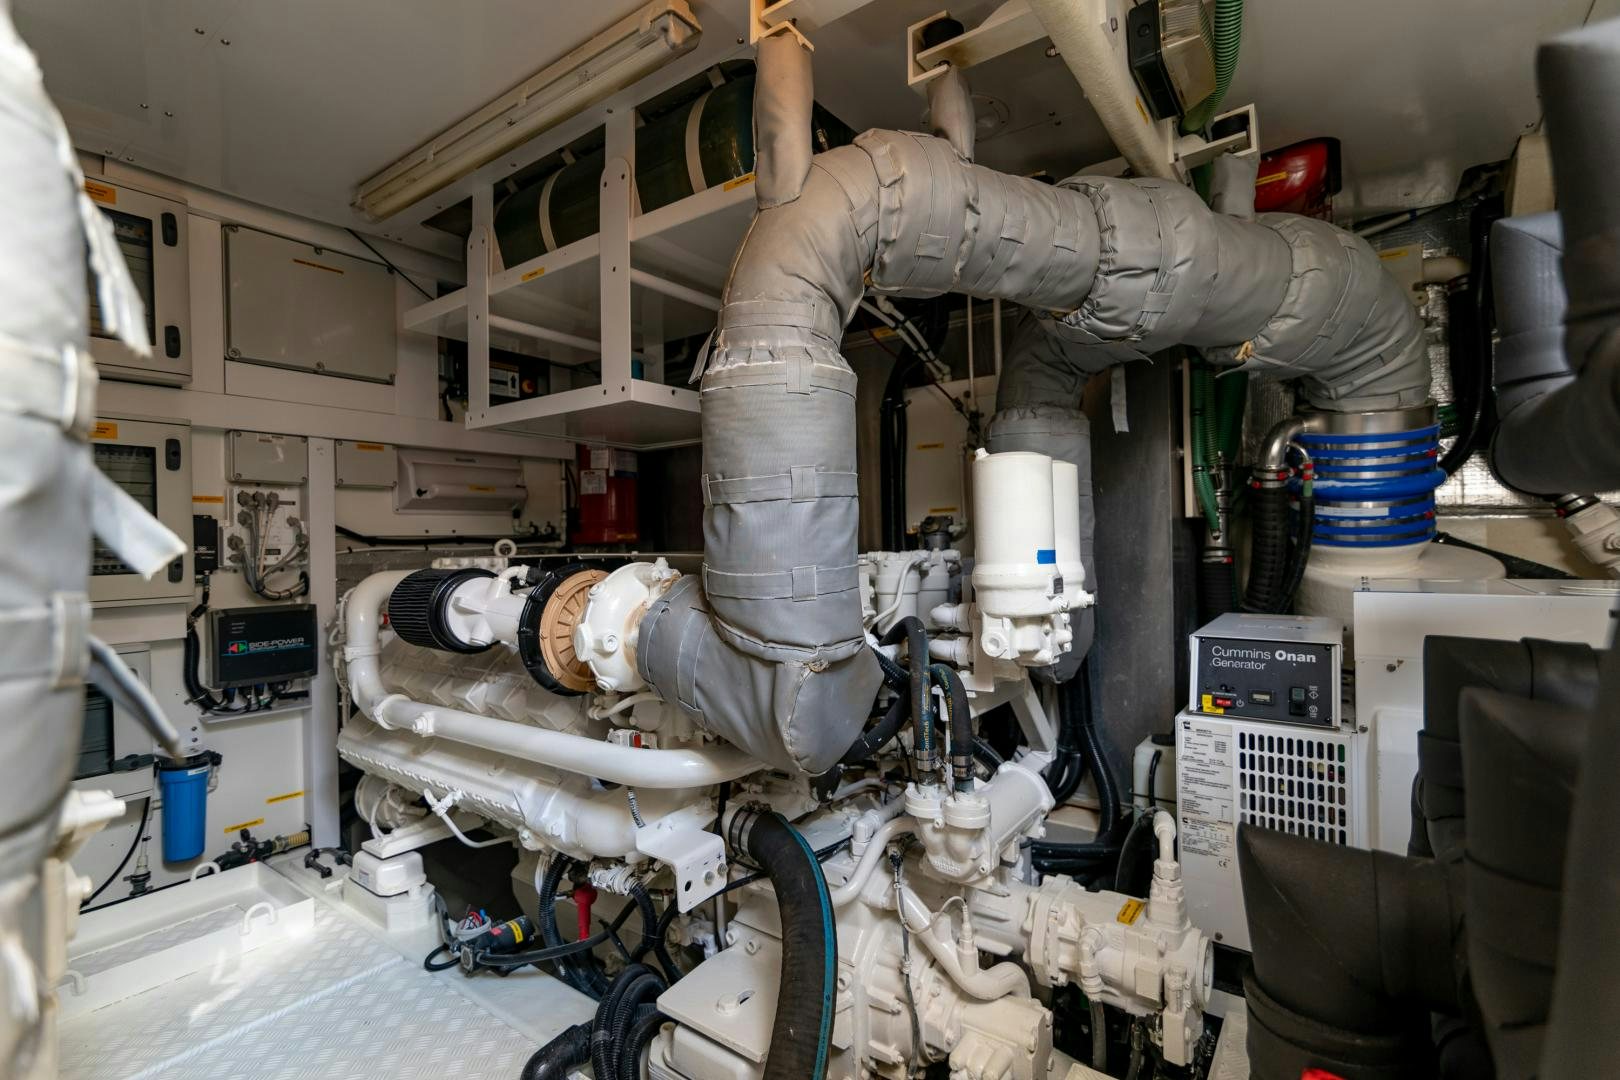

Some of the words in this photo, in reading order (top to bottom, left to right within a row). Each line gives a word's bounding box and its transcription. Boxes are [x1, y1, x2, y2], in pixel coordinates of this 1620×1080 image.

[1211, 645, 1271, 660] Cummins
[1274, 649, 1317, 663] Onan
[1211, 657, 1267, 670] Generator
